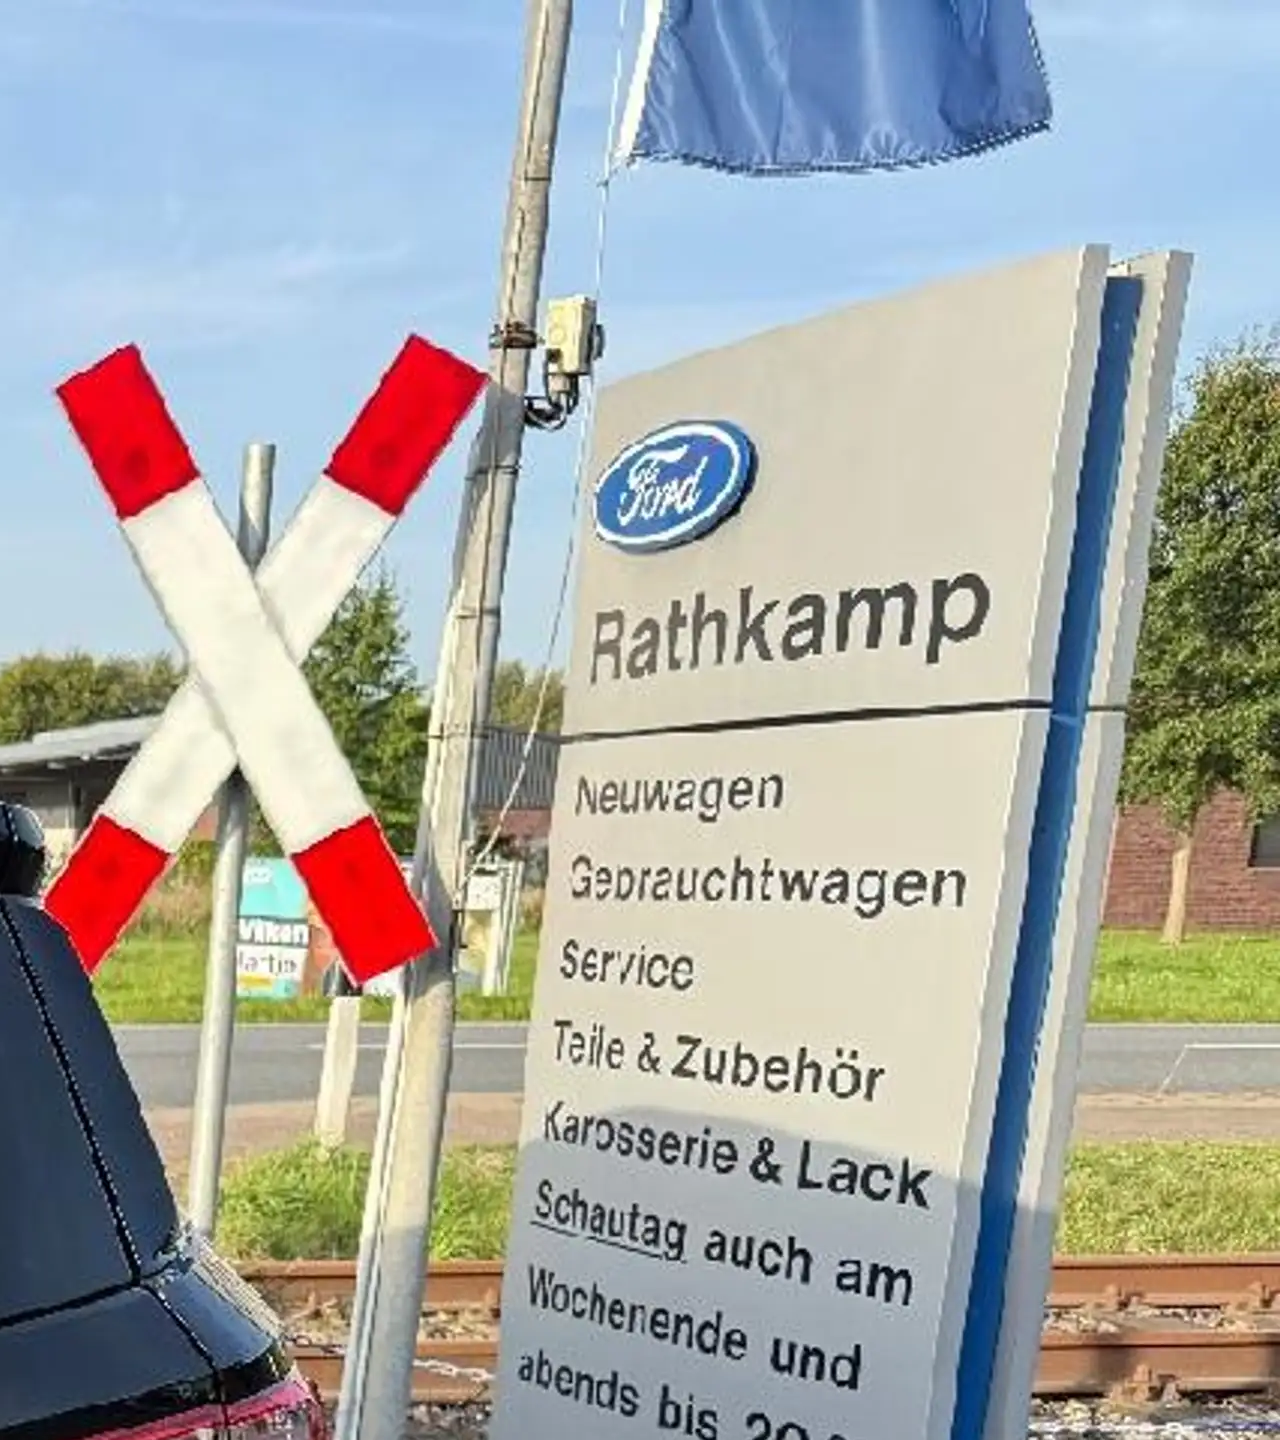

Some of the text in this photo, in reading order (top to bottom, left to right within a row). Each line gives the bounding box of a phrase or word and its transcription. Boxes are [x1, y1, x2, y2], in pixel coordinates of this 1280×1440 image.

[616, 444, 708, 527] Ford
[590, 572, 992, 684] Rathkamp
[574, 773, 785, 823] Neuwagen
[570, 855, 968, 920] Gebrauchtwagen
[560, 938, 694, 991] Service
[553, 1020, 886, 1102] Teile & Zubehör
[542, 1101, 934, 1210] Karosserie & Lack
[534, 1178, 914, 1306] Schautag auch am
[527, 1263, 864, 1390] Wochenende und
[517, 1349, 640, 1418] abends
